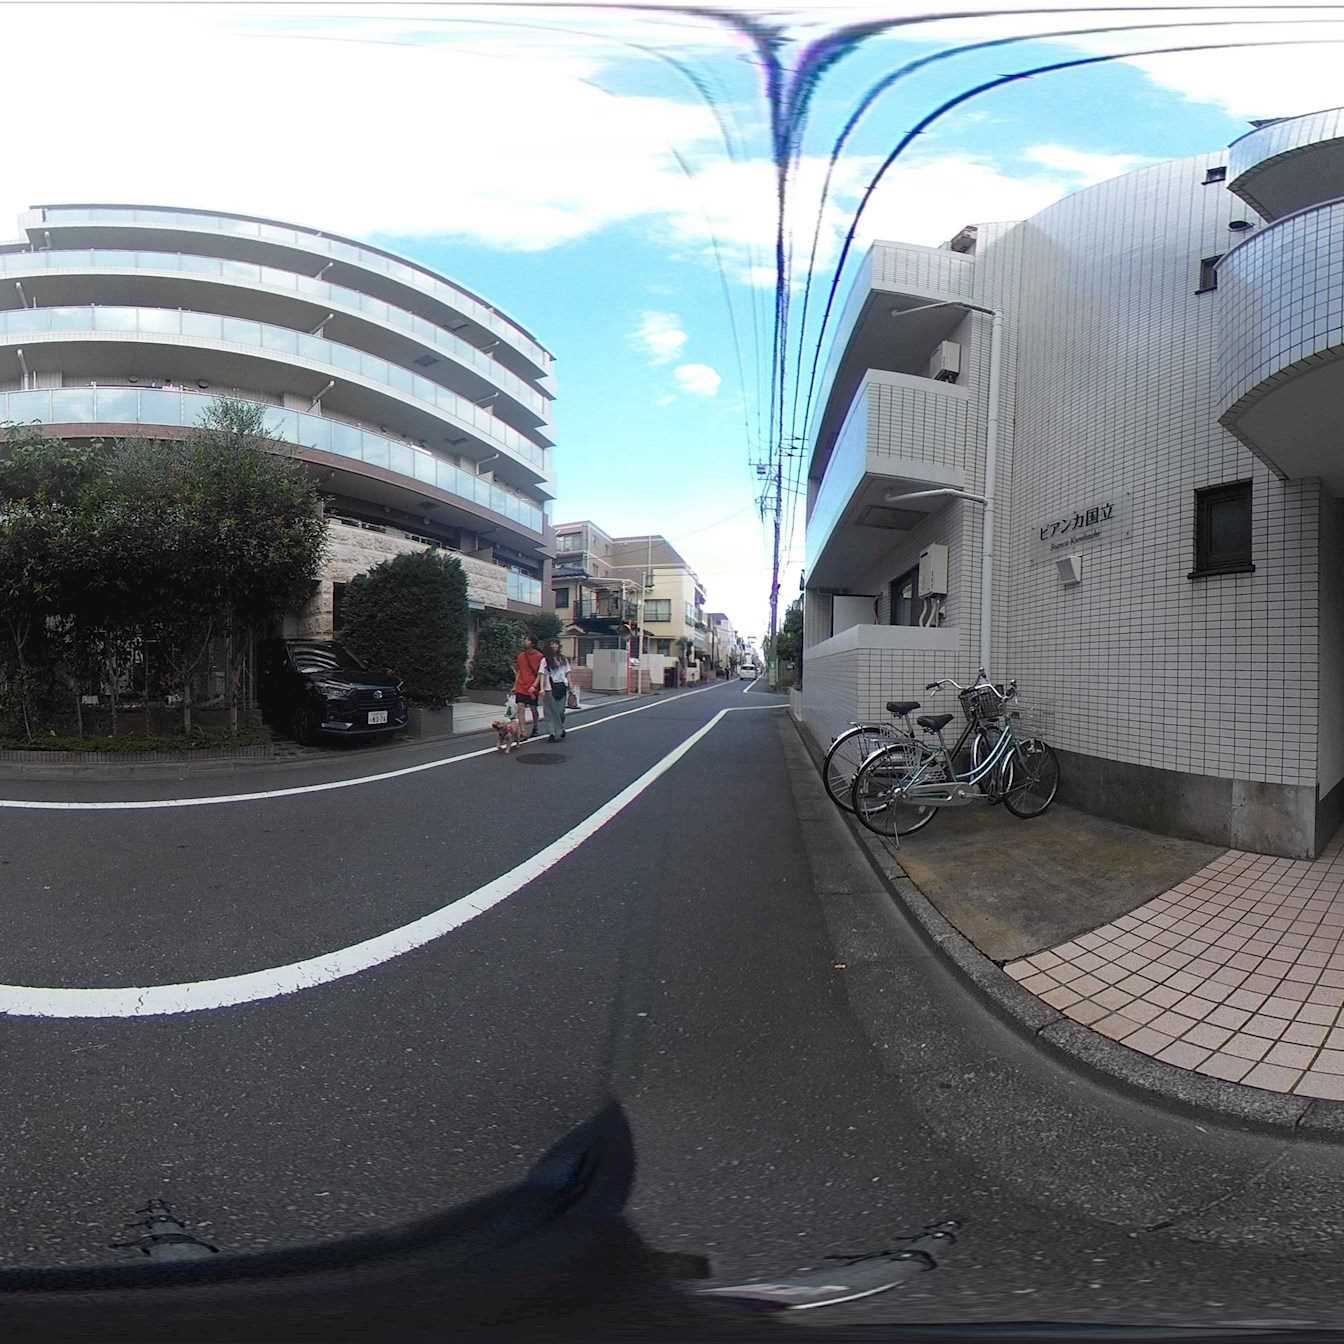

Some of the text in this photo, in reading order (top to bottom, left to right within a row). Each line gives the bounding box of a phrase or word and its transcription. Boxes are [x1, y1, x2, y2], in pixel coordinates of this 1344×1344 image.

[1040, 503, 1115, 541] ビアンカ国立
